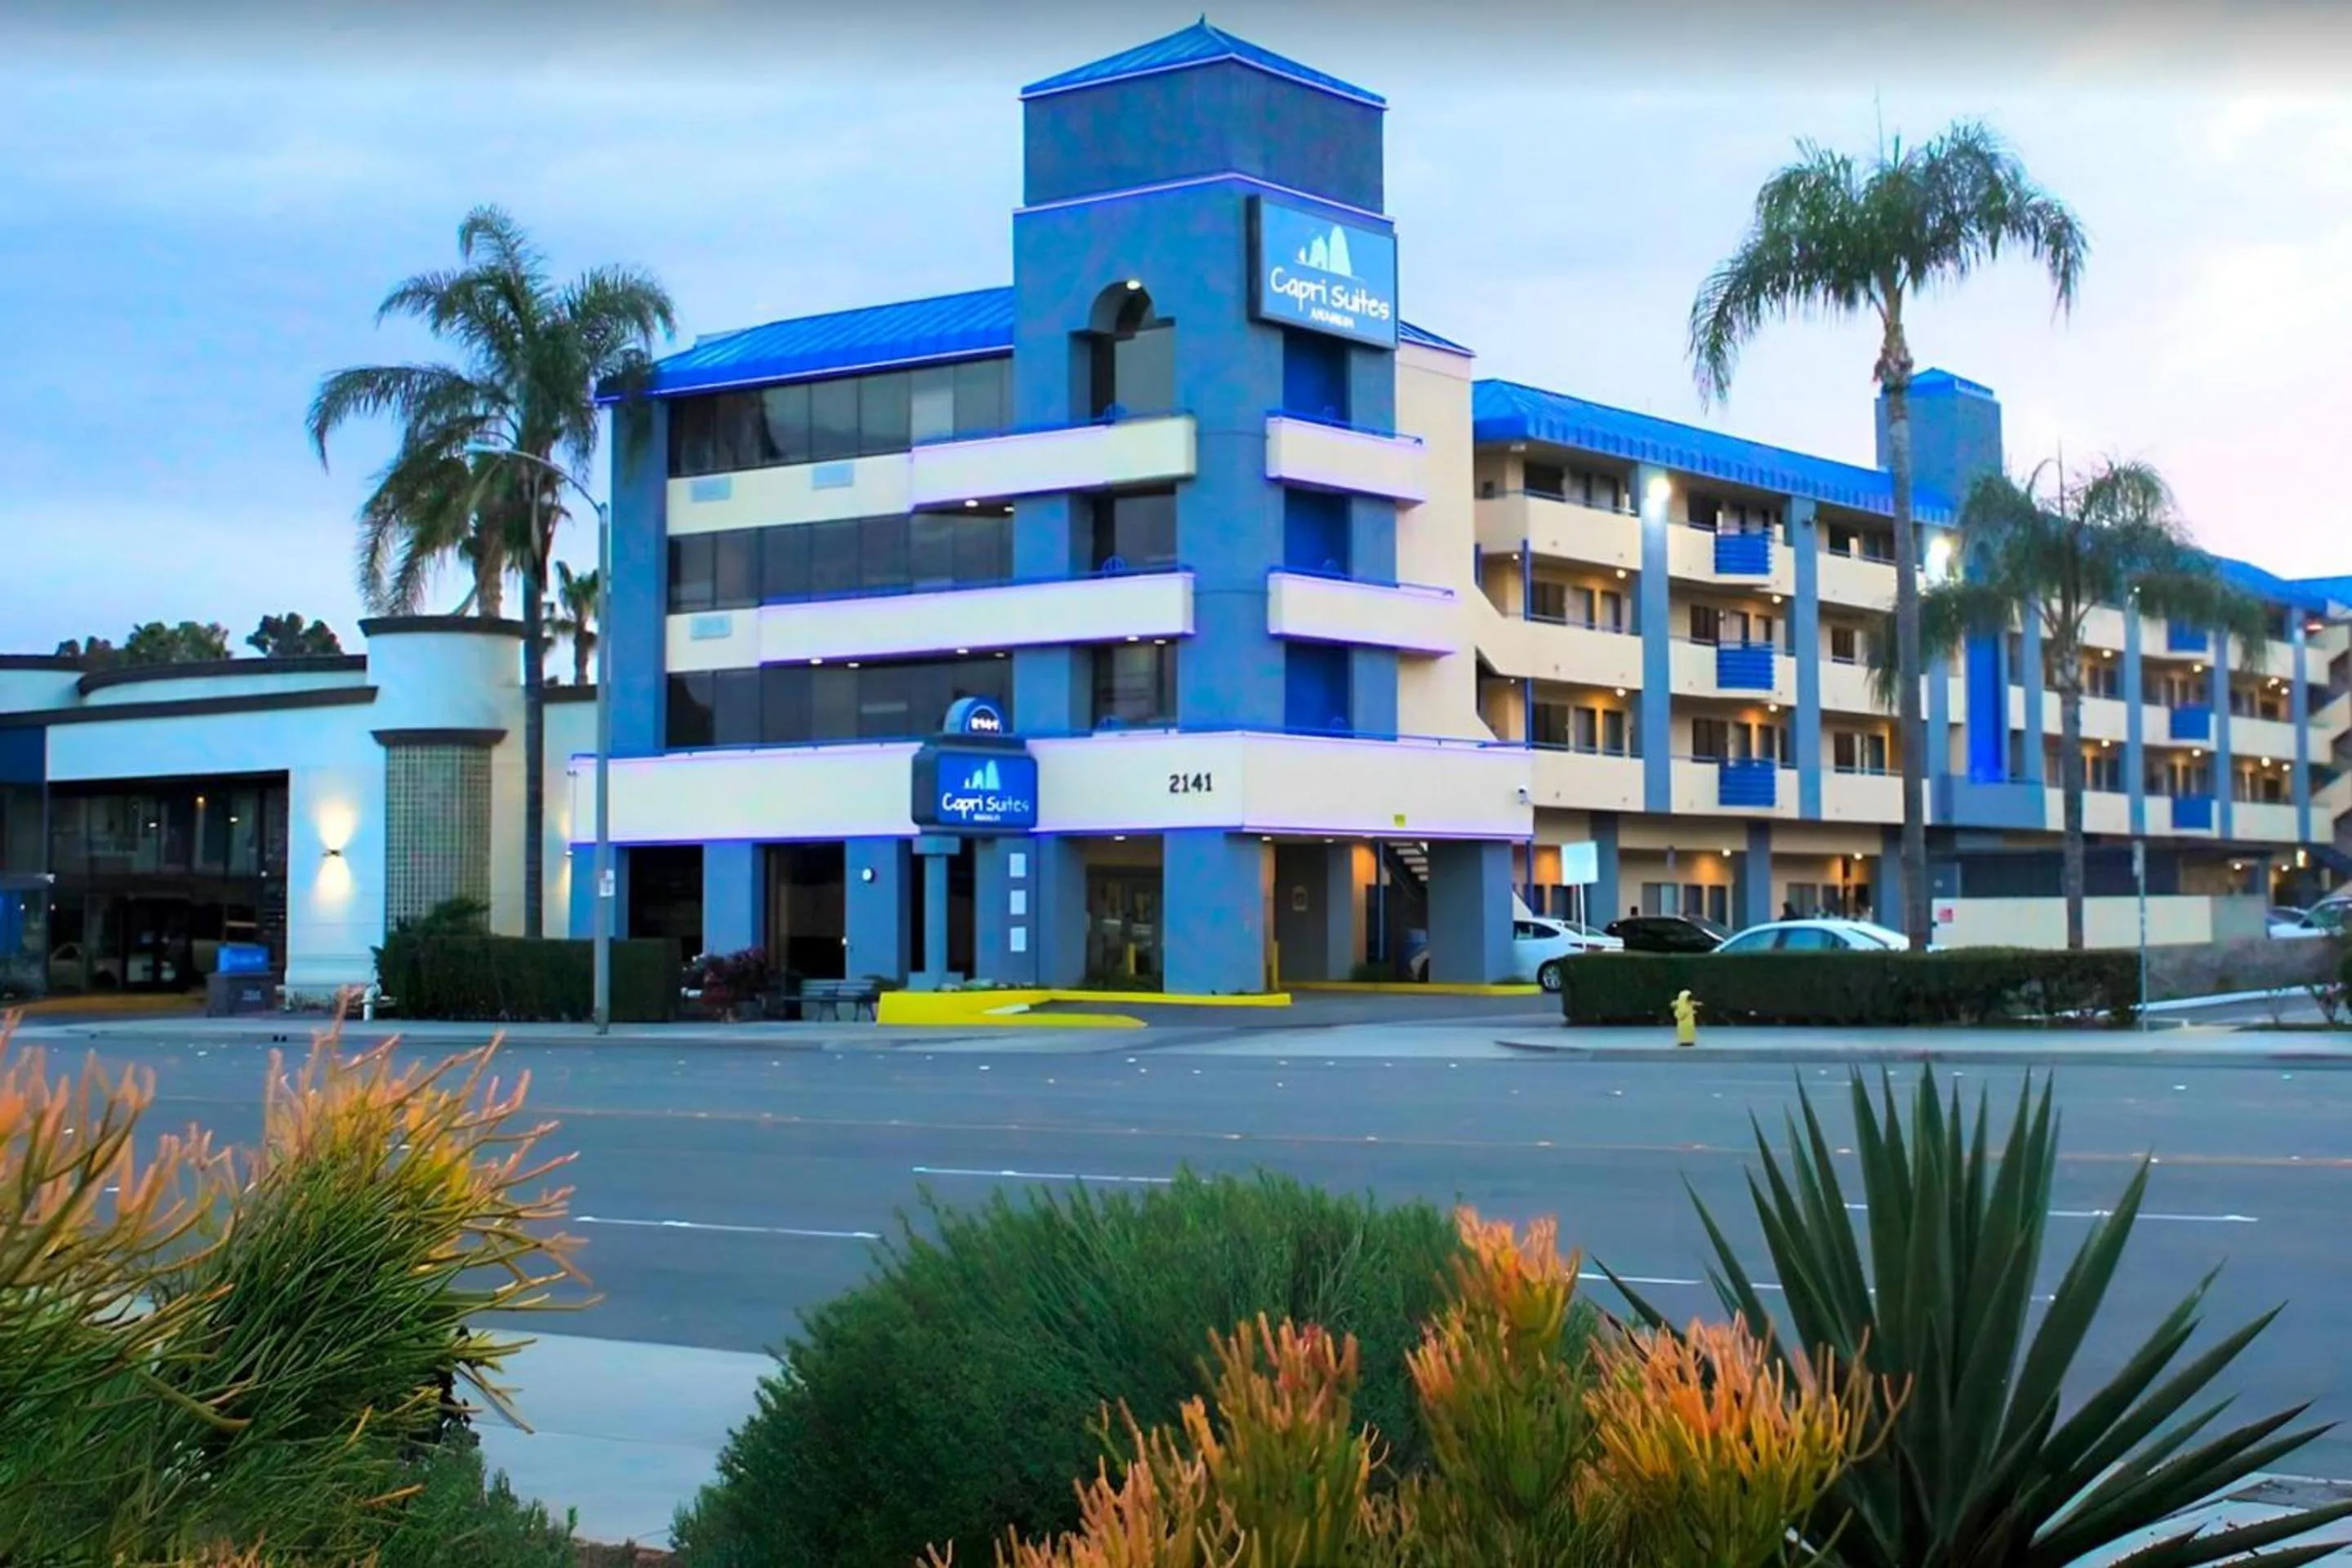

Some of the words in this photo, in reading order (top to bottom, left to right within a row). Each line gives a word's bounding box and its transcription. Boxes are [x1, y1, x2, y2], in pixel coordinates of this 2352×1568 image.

[1270, 267, 1326, 312] Capri
[1330, 284, 1390, 320] Suites
[1169, 772, 1212, 794] 2141
[942, 792, 983, 819] Capri
[986, 795, 1029, 813] Suites
